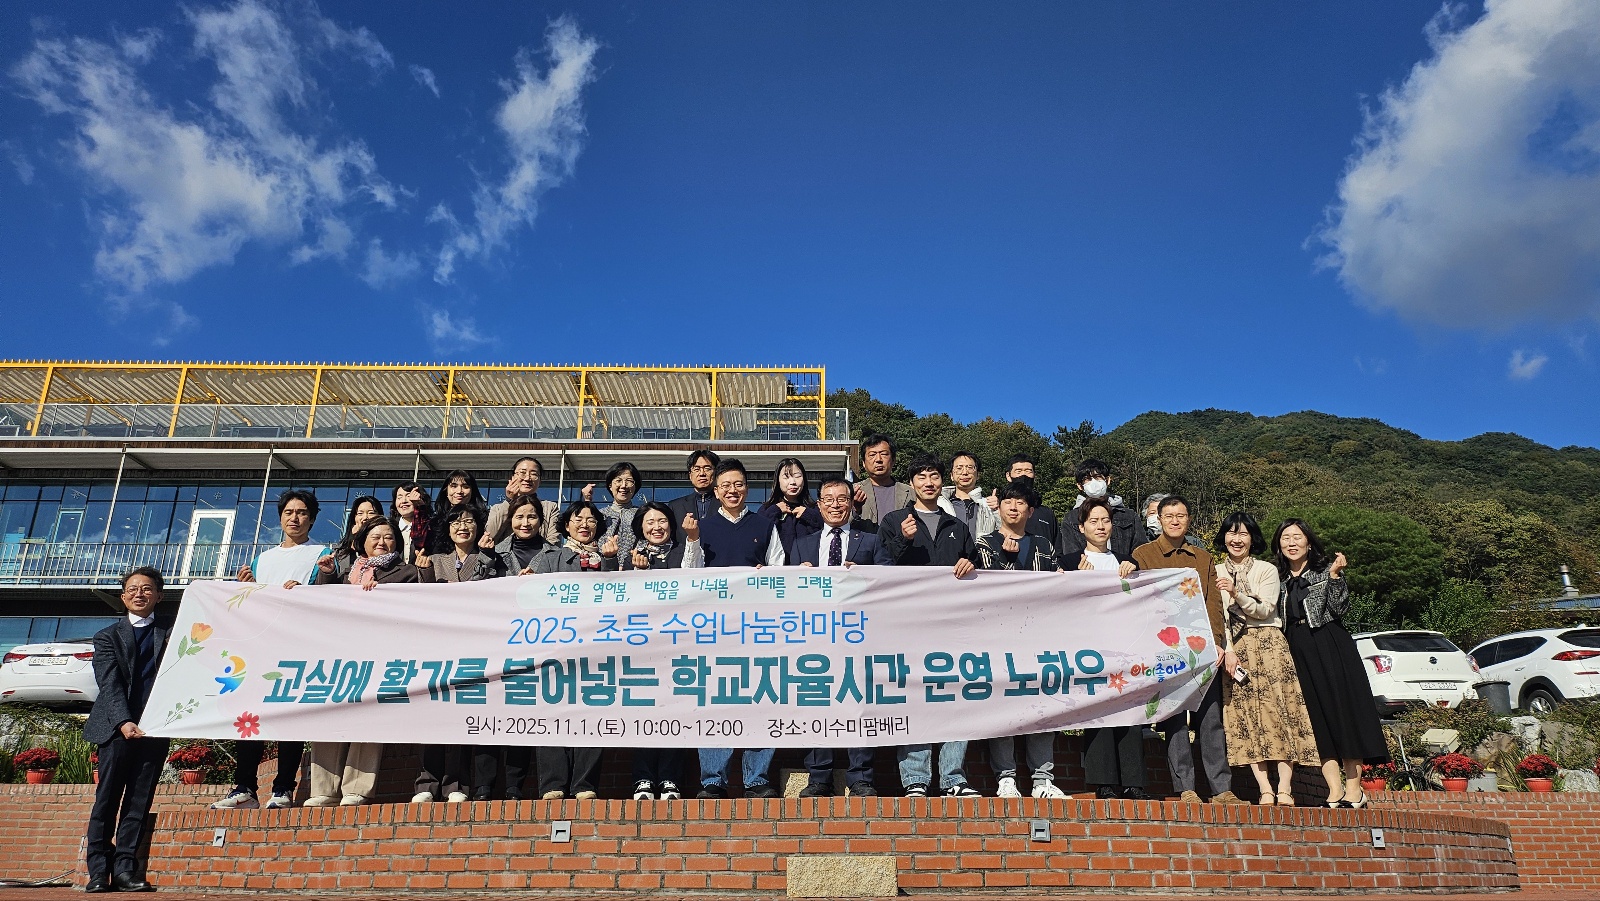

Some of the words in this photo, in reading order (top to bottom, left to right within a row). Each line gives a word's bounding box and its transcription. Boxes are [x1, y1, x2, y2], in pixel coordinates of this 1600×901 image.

[546, 583, 581, 604] 수업을
[593, 582, 631, 604] 열어봄,
[644, 580, 679, 601] 배움을
[691, 577, 734, 600] 나눠봄,
[747, 576, 785, 598] 미래를
[798, 576, 832, 598] 그려봄
[507, 616, 584, 645] 2025.
[592, 613, 653, 646] 초등
[660, 610, 869, 645] 수업나눔한마당
[262, 659, 374, 704] 교실에
[376, 658, 489, 704] 활기를
[503, 656, 659, 706] 불어넣는
[672, 654, 910, 706] 학교자율시간
[923, 652, 992, 702] 운영
[1005, 649, 1107, 696] 노하우
[1130, 660, 1187, 683] 아이좋아
[466, 716, 501, 735] 일시:
[634, 720, 743, 736] 10:00~12:00
[768, 719, 806, 738] 장소:
[812, 716, 909, 737] 이수미팜베리
